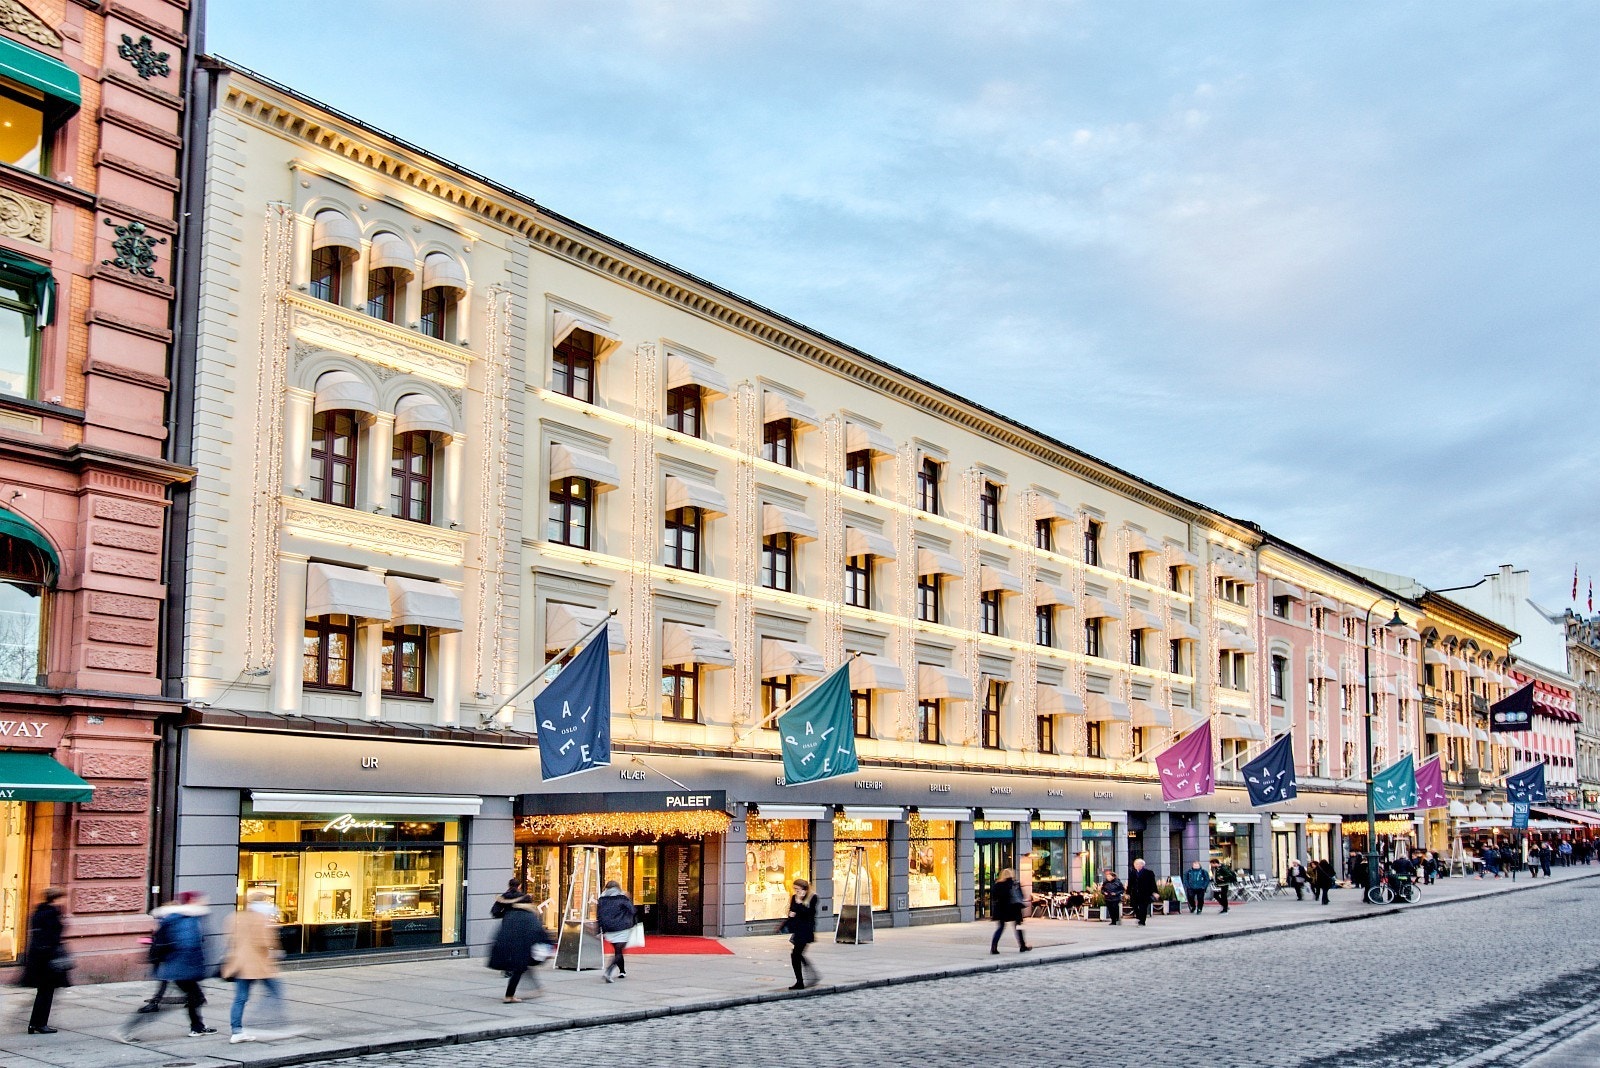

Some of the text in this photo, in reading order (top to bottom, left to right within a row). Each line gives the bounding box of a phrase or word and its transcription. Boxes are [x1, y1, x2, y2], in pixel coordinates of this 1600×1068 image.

[561, 725, 578, 735] OSLO
[361, 756, 379, 768] UR
[620, 769, 646, 780] KLÆR
[776, 776, 786, 786] BØ
[855, 780, 883, 790] INTERIØR
[666, 795, 712, 807] PALEET
[314, 870, 351, 879] OMEGA
